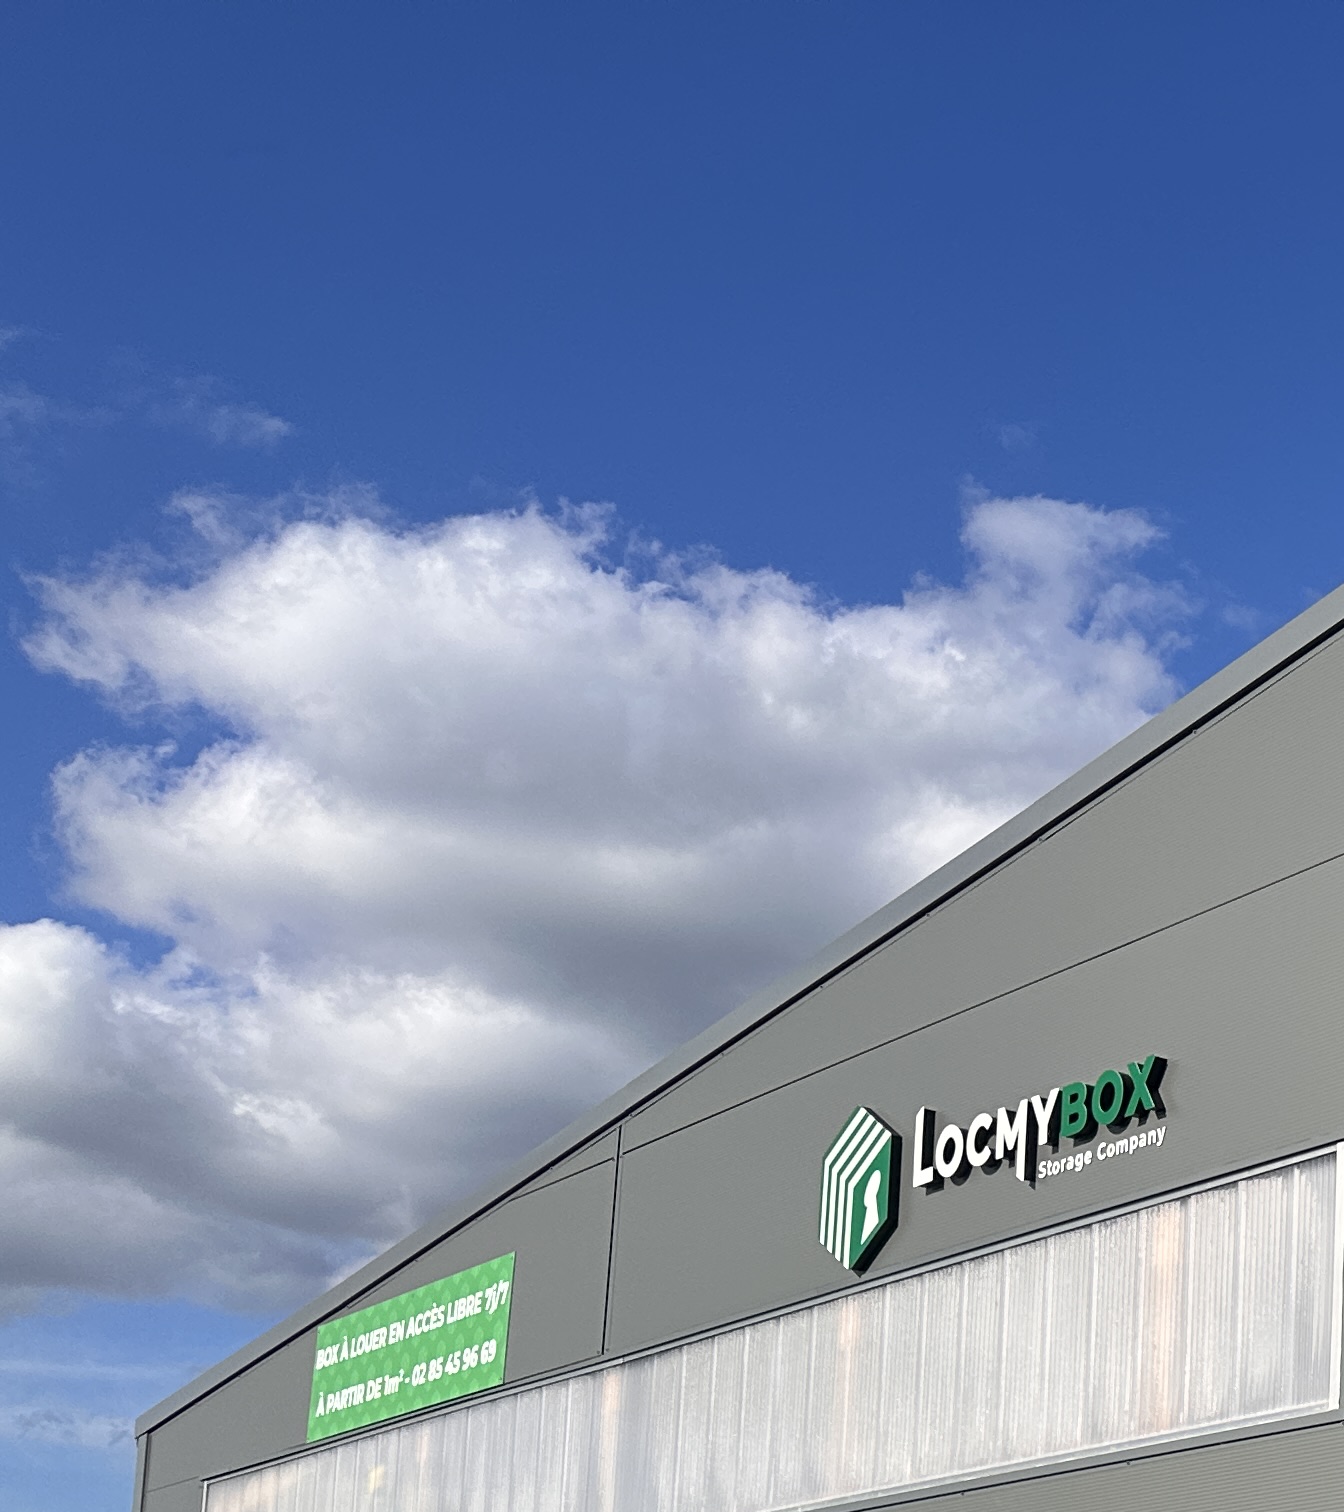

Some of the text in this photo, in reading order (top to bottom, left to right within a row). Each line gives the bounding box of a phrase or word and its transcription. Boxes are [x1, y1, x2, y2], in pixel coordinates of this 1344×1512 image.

[1038, 1125, 1166, 1178] Storage Company
[316, 1280, 509, 1370] BOX À LOUER EN ACCÈS LIBRE 7j/7
[316, 1392, 324, 1417] À
[326, 1384, 364, 1414] PARTIR
[366, 1377, 382, 1401] DE
[412, 1364, 426, 1386] 02
[428, 1357, 443, 1381] 85
[445, 1351, 461, 1375] 45
[462, 1345, 478, 1372] 96
[480, 1339, 497, 1364] 69
